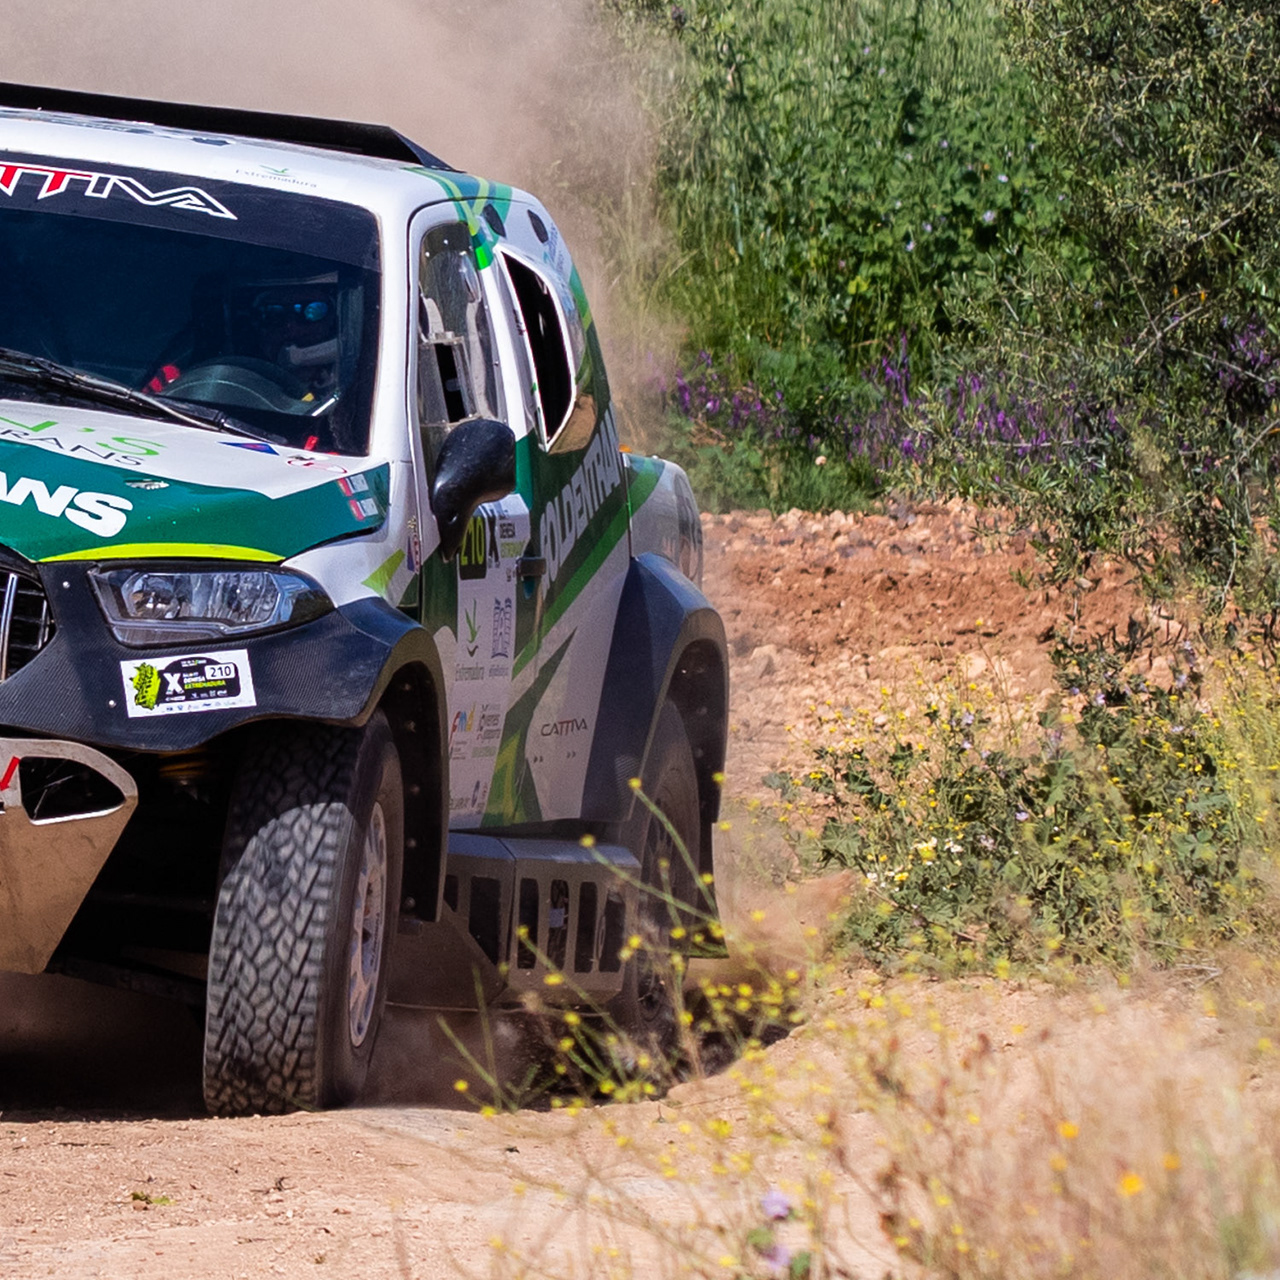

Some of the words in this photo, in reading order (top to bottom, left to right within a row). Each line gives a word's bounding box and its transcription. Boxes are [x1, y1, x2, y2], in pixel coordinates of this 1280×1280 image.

[210, 665, 232, 678] 210
[163, 673, 184, 695] X
[541, 718, 587, 736] CATTIVA
